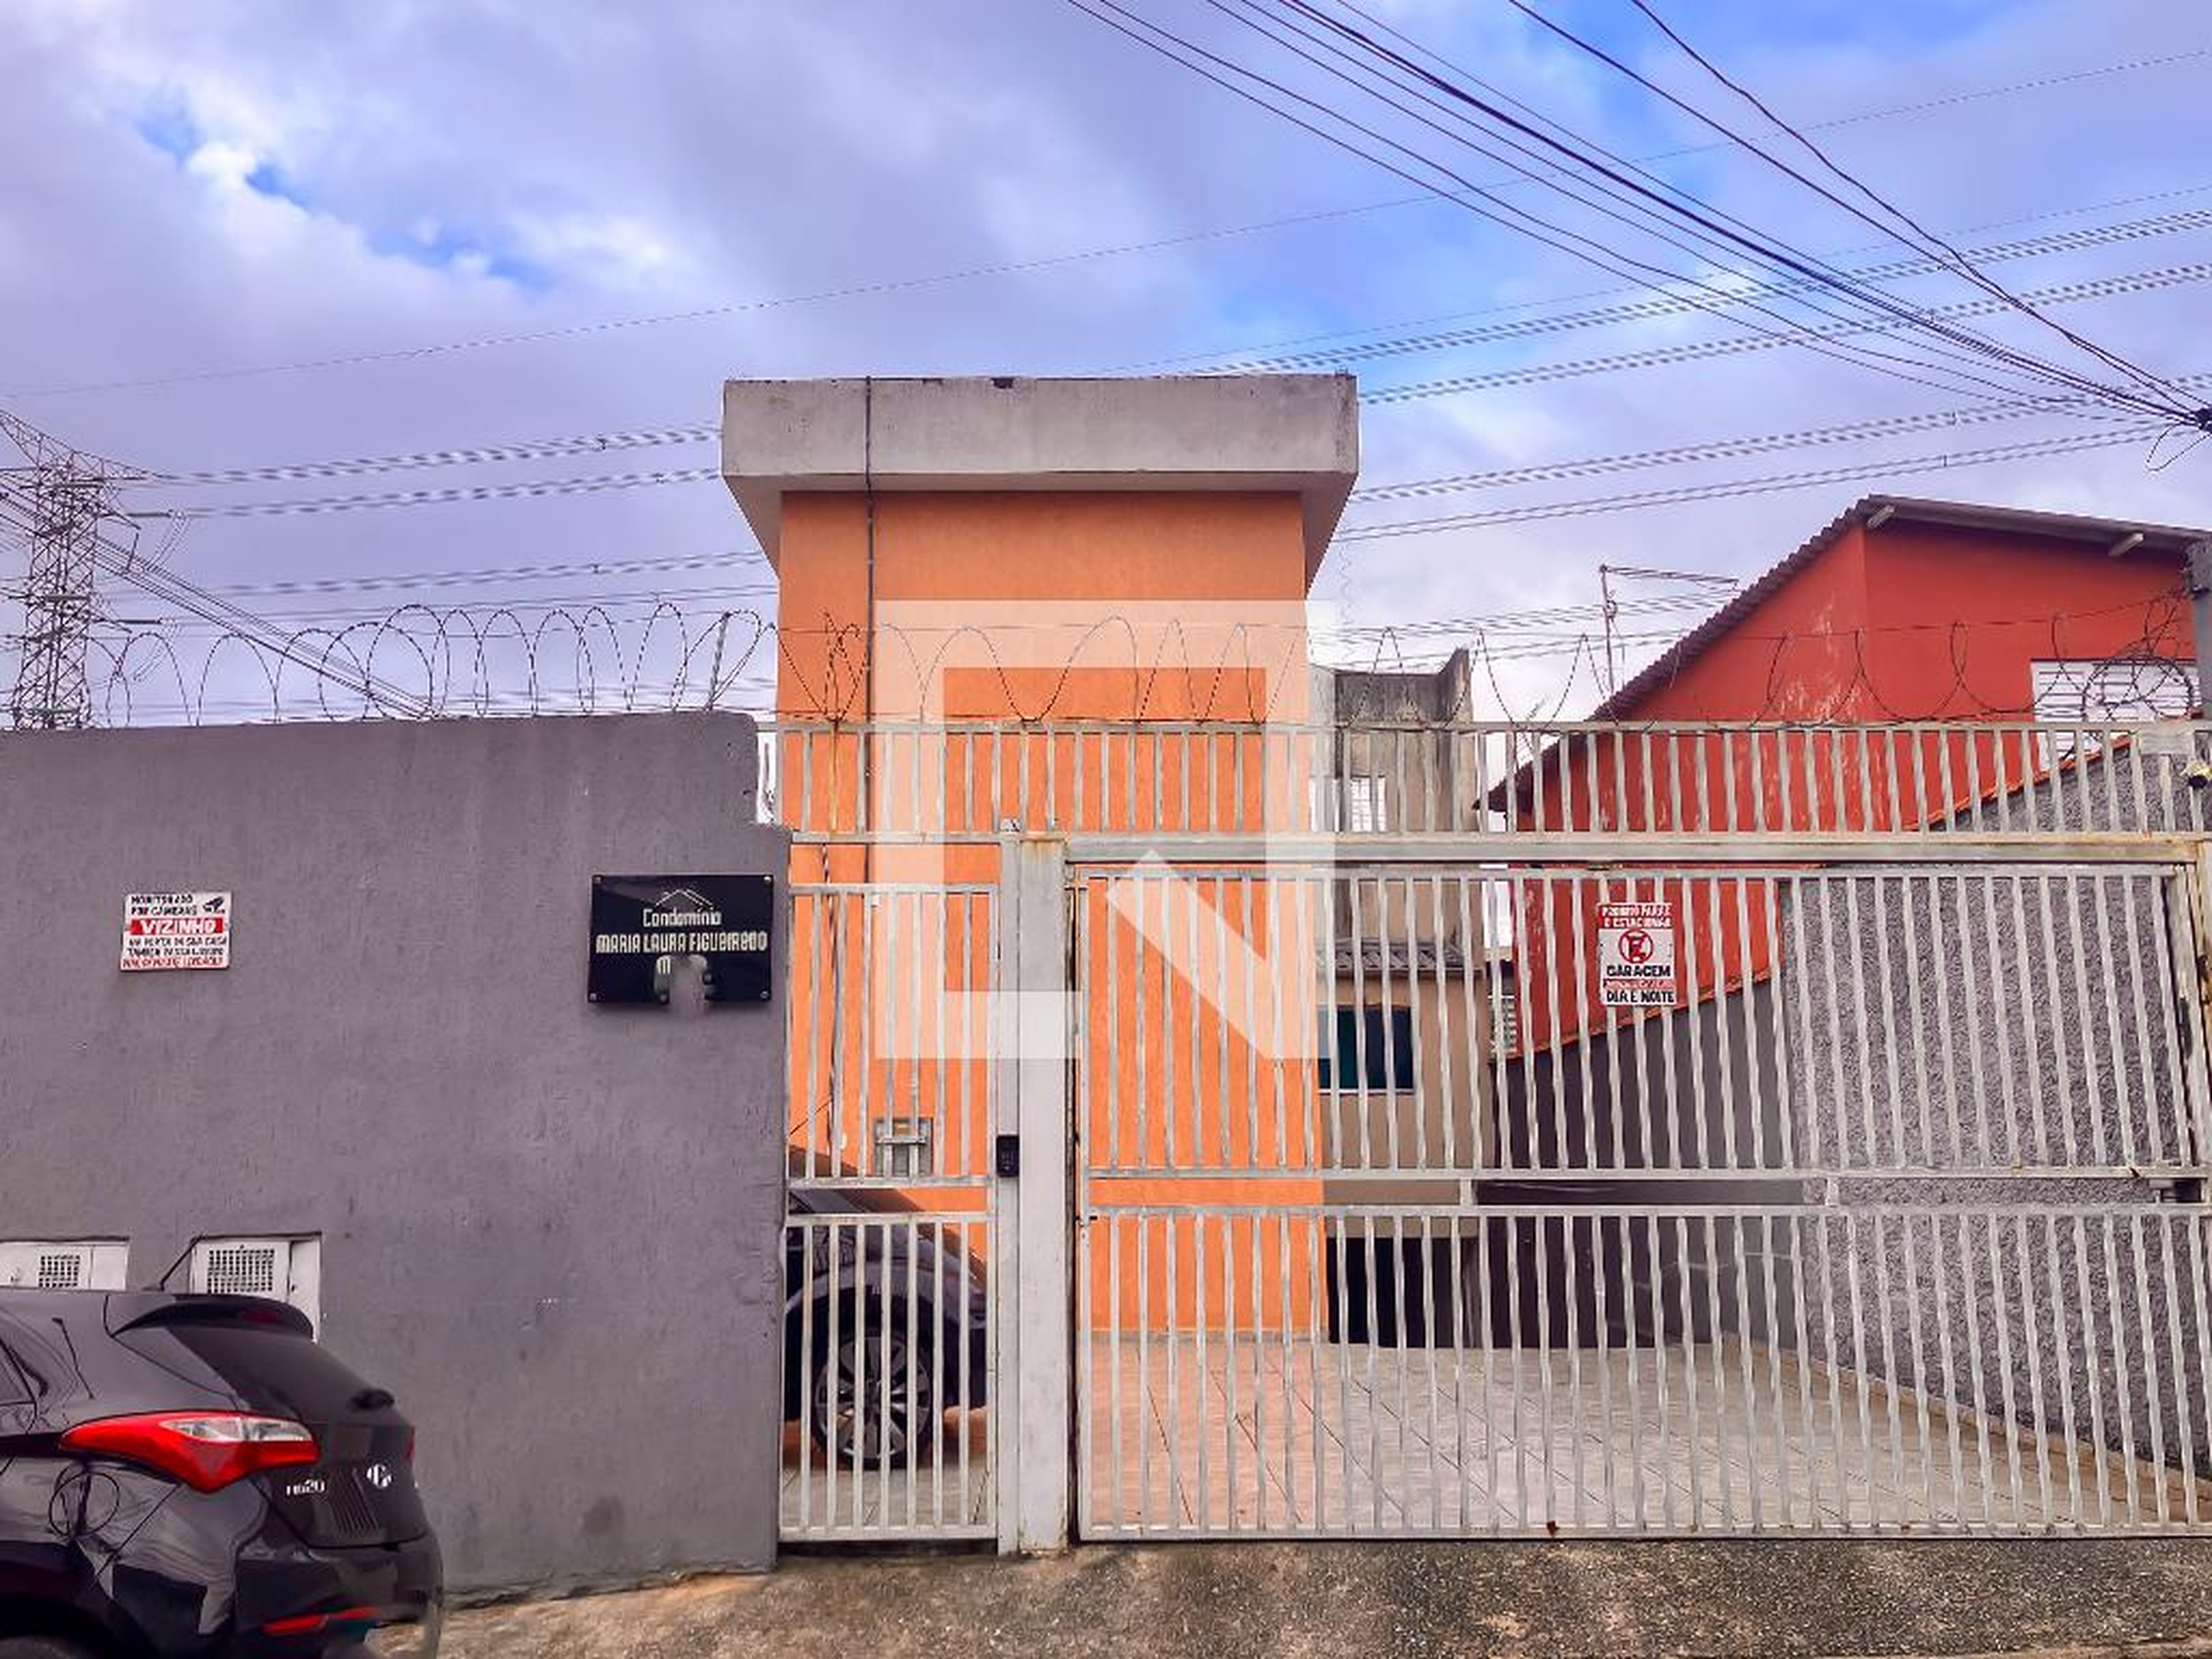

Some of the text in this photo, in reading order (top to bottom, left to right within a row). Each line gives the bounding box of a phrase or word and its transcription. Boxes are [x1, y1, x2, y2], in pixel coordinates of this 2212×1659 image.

[643, 907, 721, 927] Condomínio
[142, 919, 217, 935] VIZINHO
[596, 934, 641, 953] MARIA
[643, 933, 686, 953] LAURA
[1607, 991, 1627, 1002] DIA
[1631, 991, 1638, 1002] E
